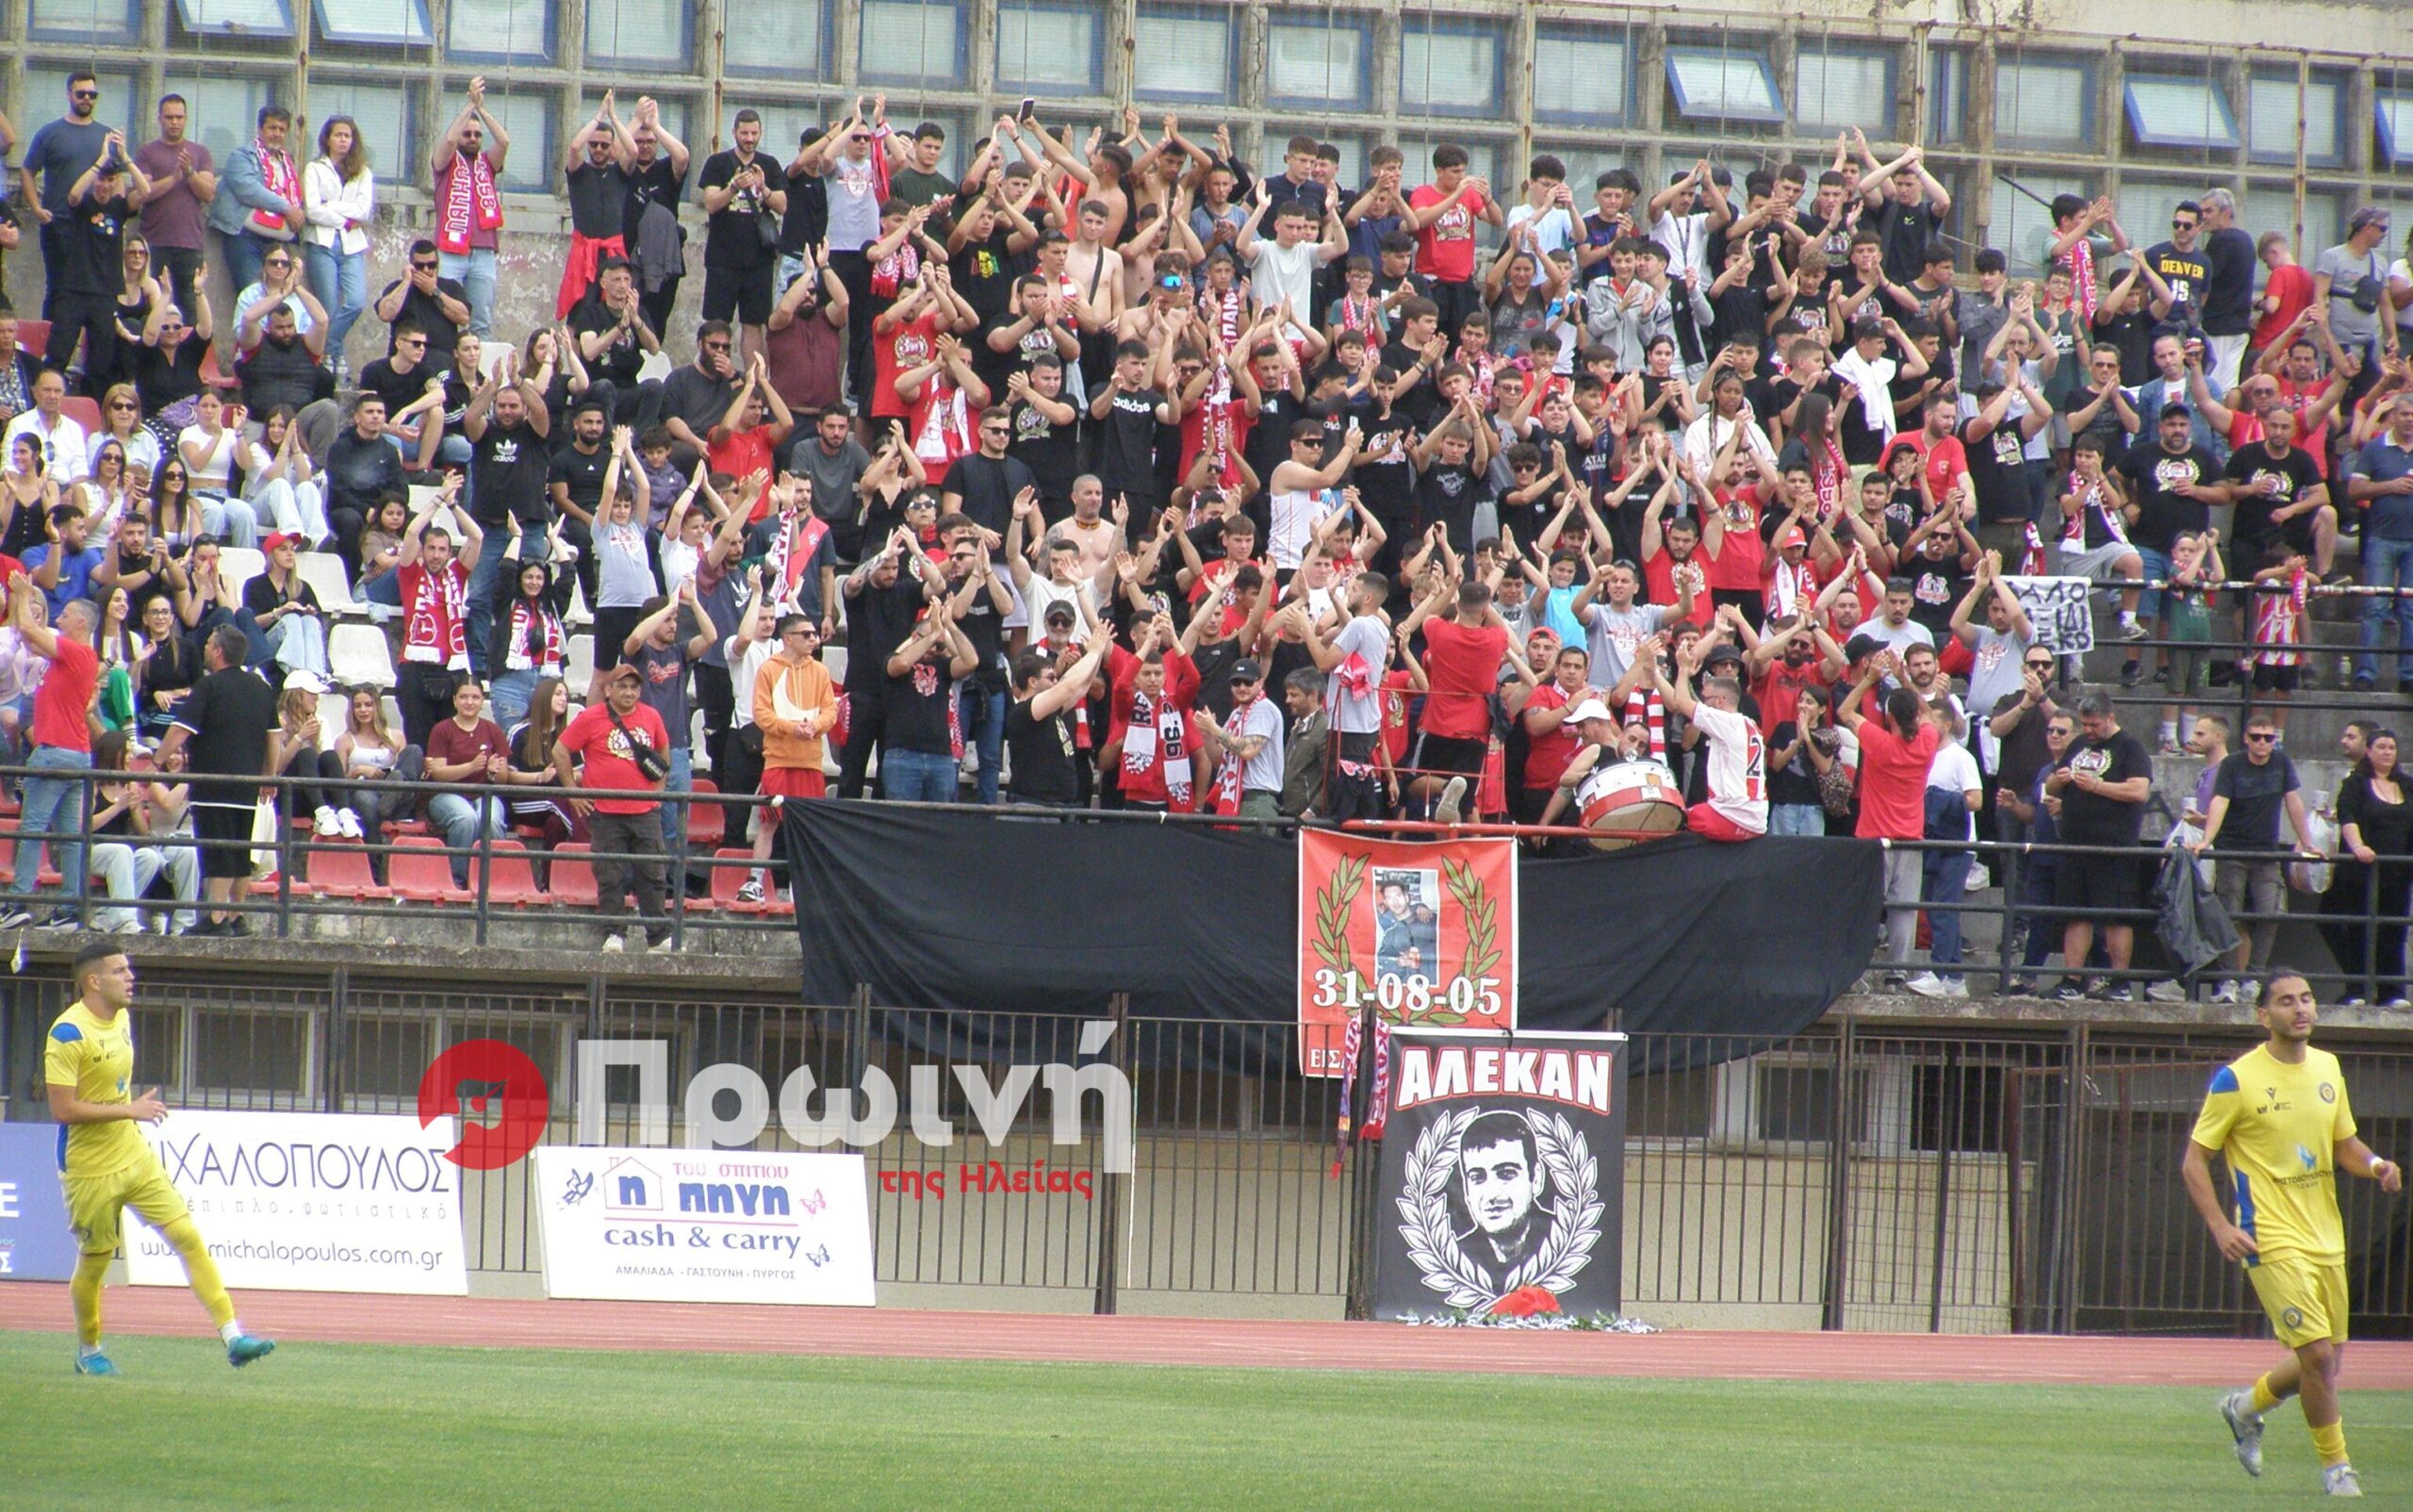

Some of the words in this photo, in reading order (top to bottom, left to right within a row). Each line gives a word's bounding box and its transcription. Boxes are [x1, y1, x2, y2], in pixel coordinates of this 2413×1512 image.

[2160, 258, 2204, 279] DENVER
[2171, 278, 2190, 302] 15
[1313, 969, 1502, 1015] 31-08-05
[1396, 1046, 1613, 1116] ΑΛΕΚΑΝ
[160, 1132, 450, 1192] ΙΧΑΛΟΠΟΥΛΟΣ
[604, 1224, 675, 1247] cash
[688, 1226, 712, 1248] &
[722, 1233, 801, 1259] carry
[616, 1266, 675, 1276] ΑΜΑΛΙΑΔΑ
[686, 1267, 744, 1278] ΓΑΣΤΟΥΝΗ
[753, 1269, 796, 1280] ΠΥΡΓΟΣ
